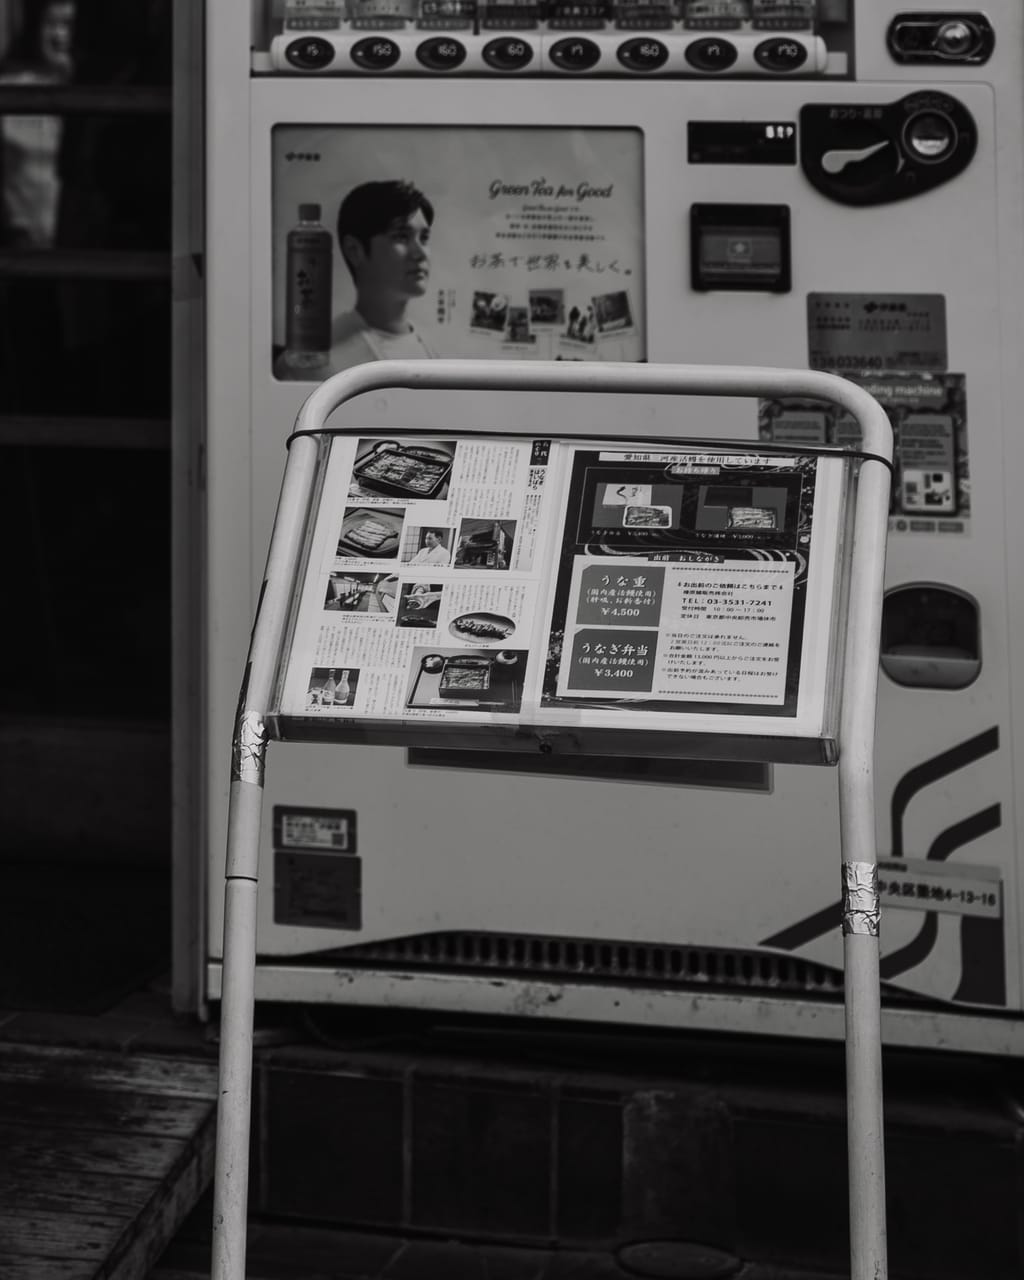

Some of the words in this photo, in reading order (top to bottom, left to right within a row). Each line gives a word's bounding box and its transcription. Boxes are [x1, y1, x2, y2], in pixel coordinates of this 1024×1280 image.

[488, 178, 530, 200] Green
[576, 180, 614, 203] Good
[601, 575, 647, 588] うな重
[582, 642, 648, 656] うなぎ弁当
[594, 669, 633, 678] ￥3,400
